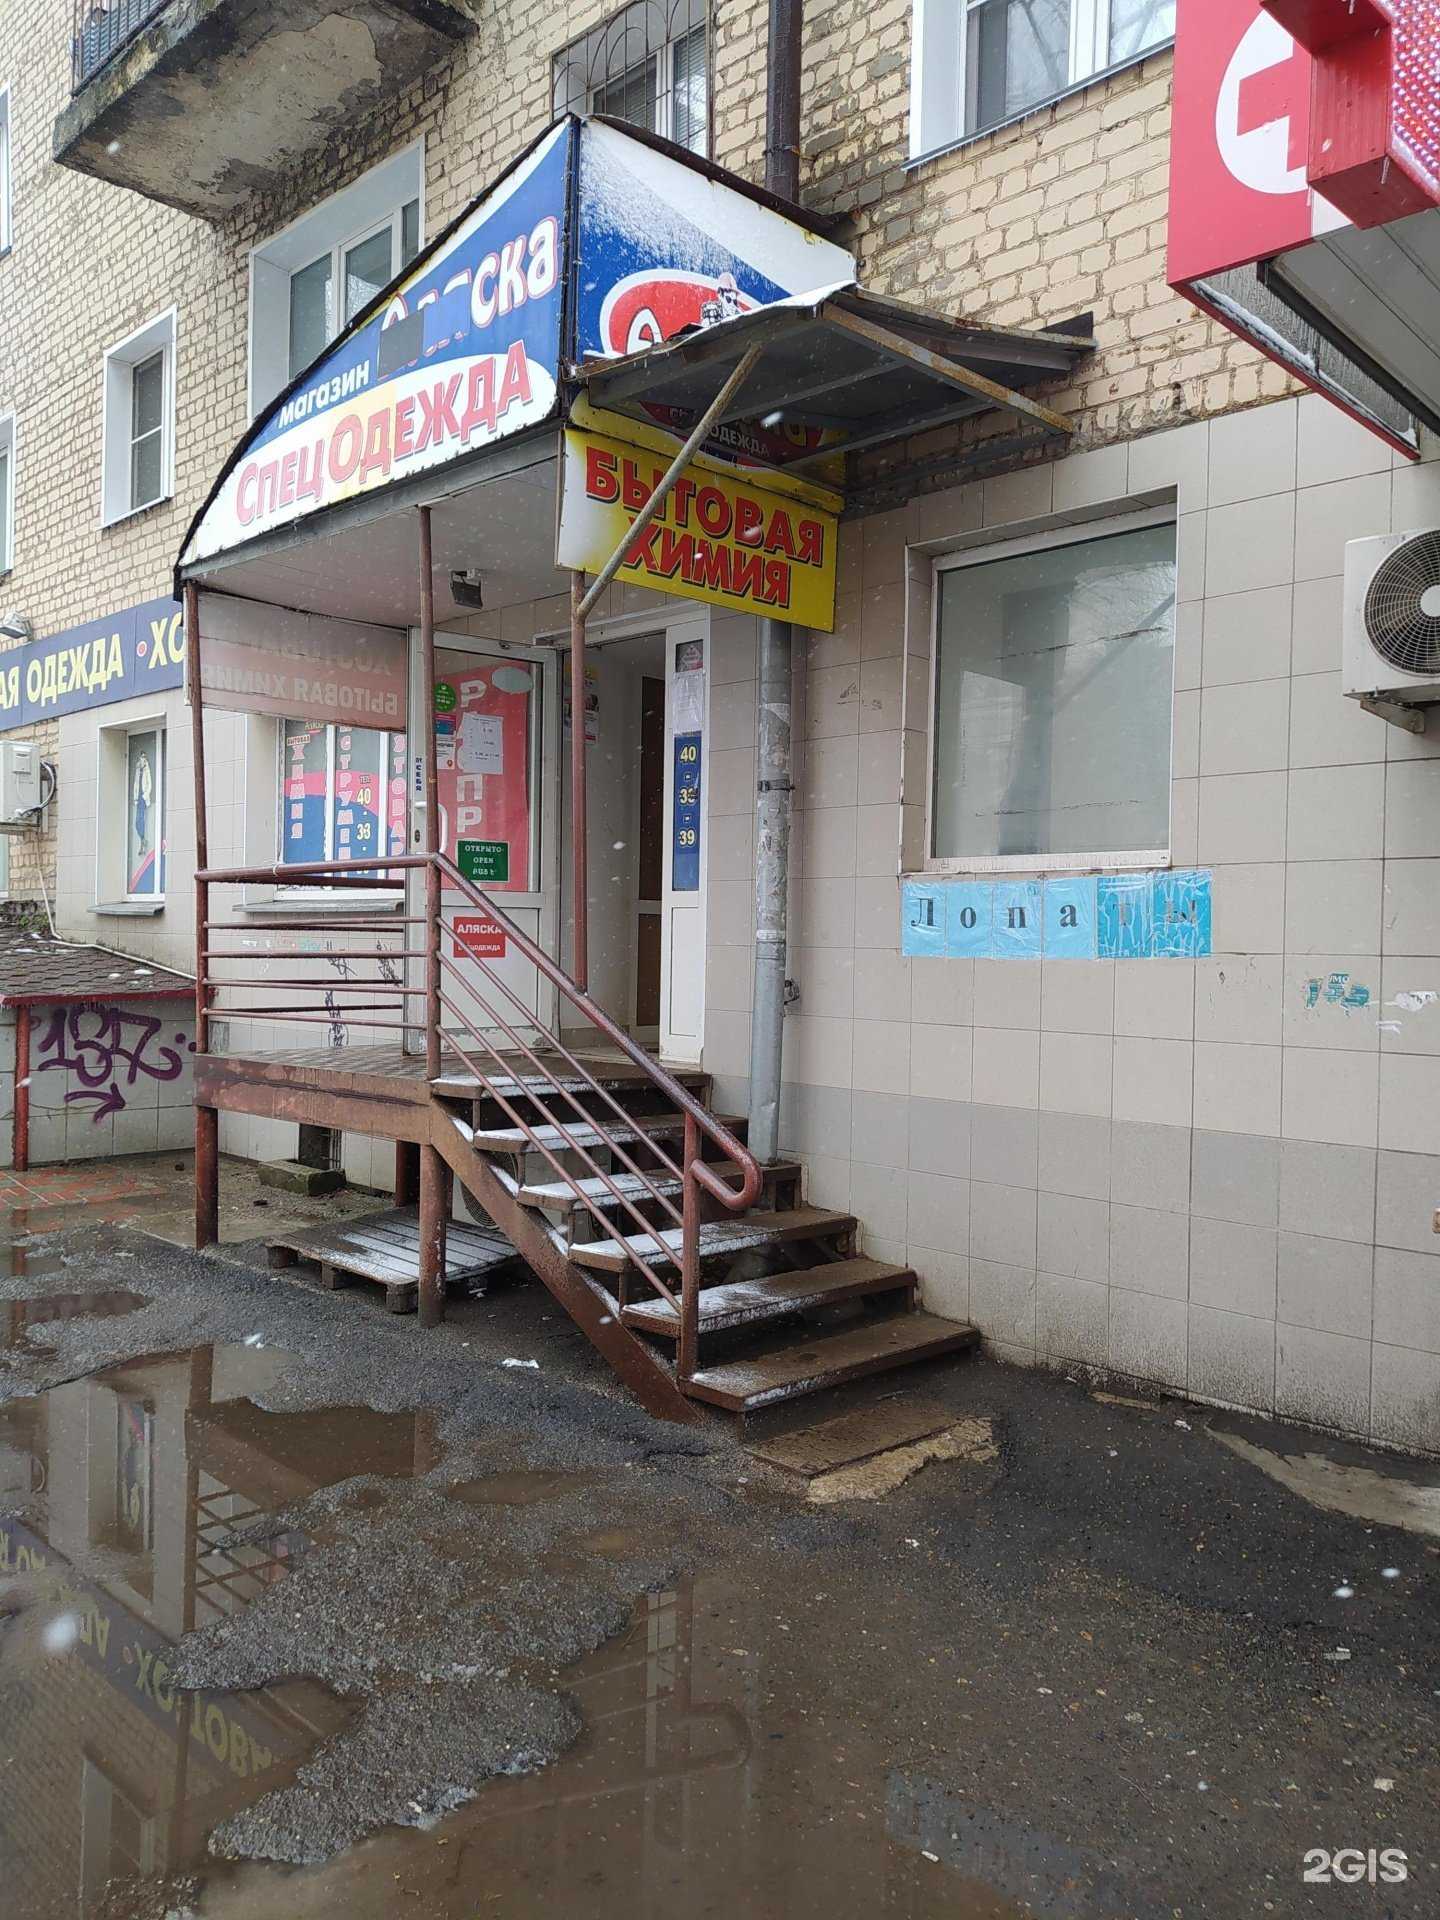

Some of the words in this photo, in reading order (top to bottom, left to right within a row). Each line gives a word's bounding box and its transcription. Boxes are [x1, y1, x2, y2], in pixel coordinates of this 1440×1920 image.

[278, 361, 370, 428] магазин
[586, 446, 824, 567] БЫТОВАЯ
[623, 517, 791, 608] ХИМИЯ
[27, 633, 124, 707] ОДЕЖДА
[680, 746, 697, 762] 40
[357, 788, 371, 805] 40
[679, 830, 695, 845] 39
